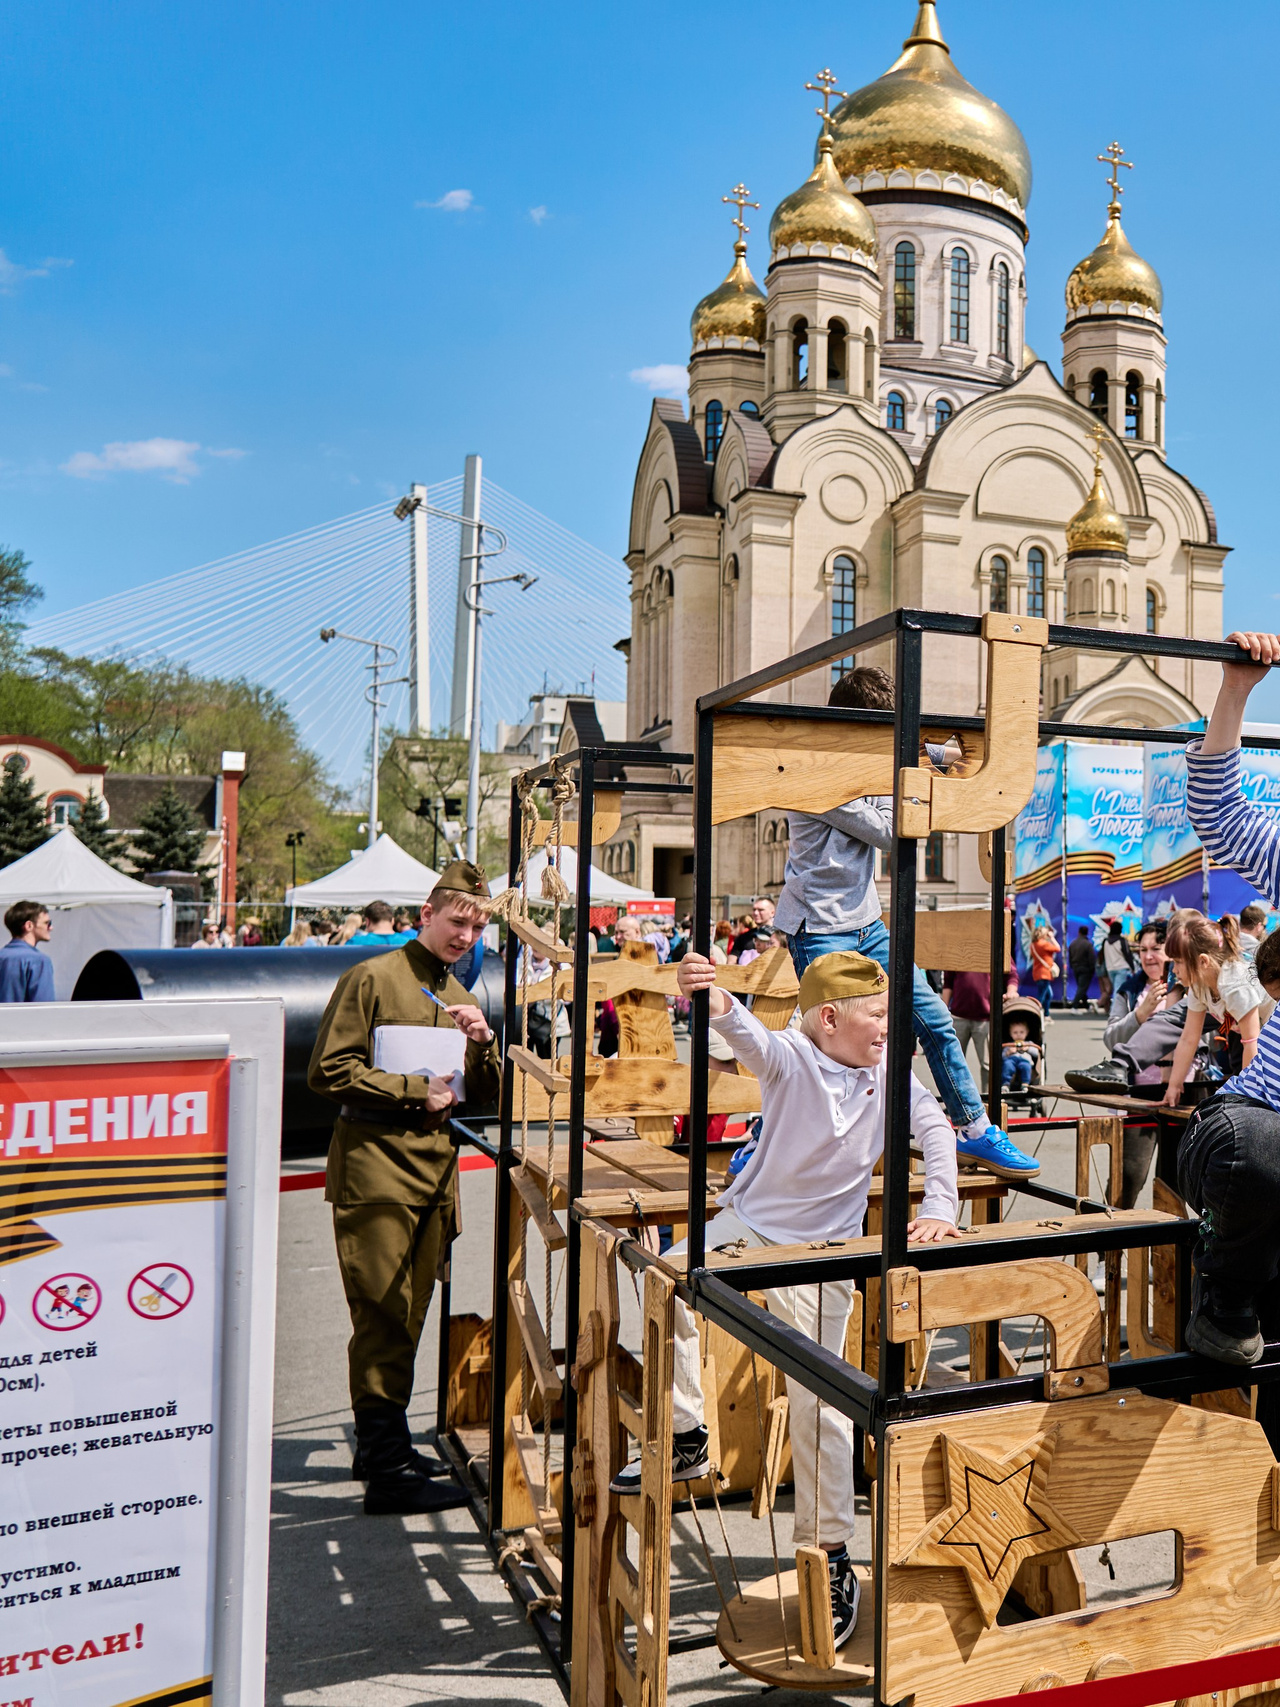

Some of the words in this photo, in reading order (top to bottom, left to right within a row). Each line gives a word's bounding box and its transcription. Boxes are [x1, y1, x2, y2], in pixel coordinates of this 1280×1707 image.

[1092, 786, 1106, 815] С
[0, 1091, 208, 1157] ДЕНИЯ
[39, 1341, 98, 1365] детей
[0, 1424, 43, 1441] еты
[49, 1402, 177, 1433] повышенной
[2, 1443, 77, 1466] прочее;
[83, 1422, 214, 1452] жевательную
[25, 1502, 115, 1532] внешней
[121, 1493, 202, 1515] стороне.
[69, 1583, 81, 1596] к
[88, 1565, 181, 1593] младшим
